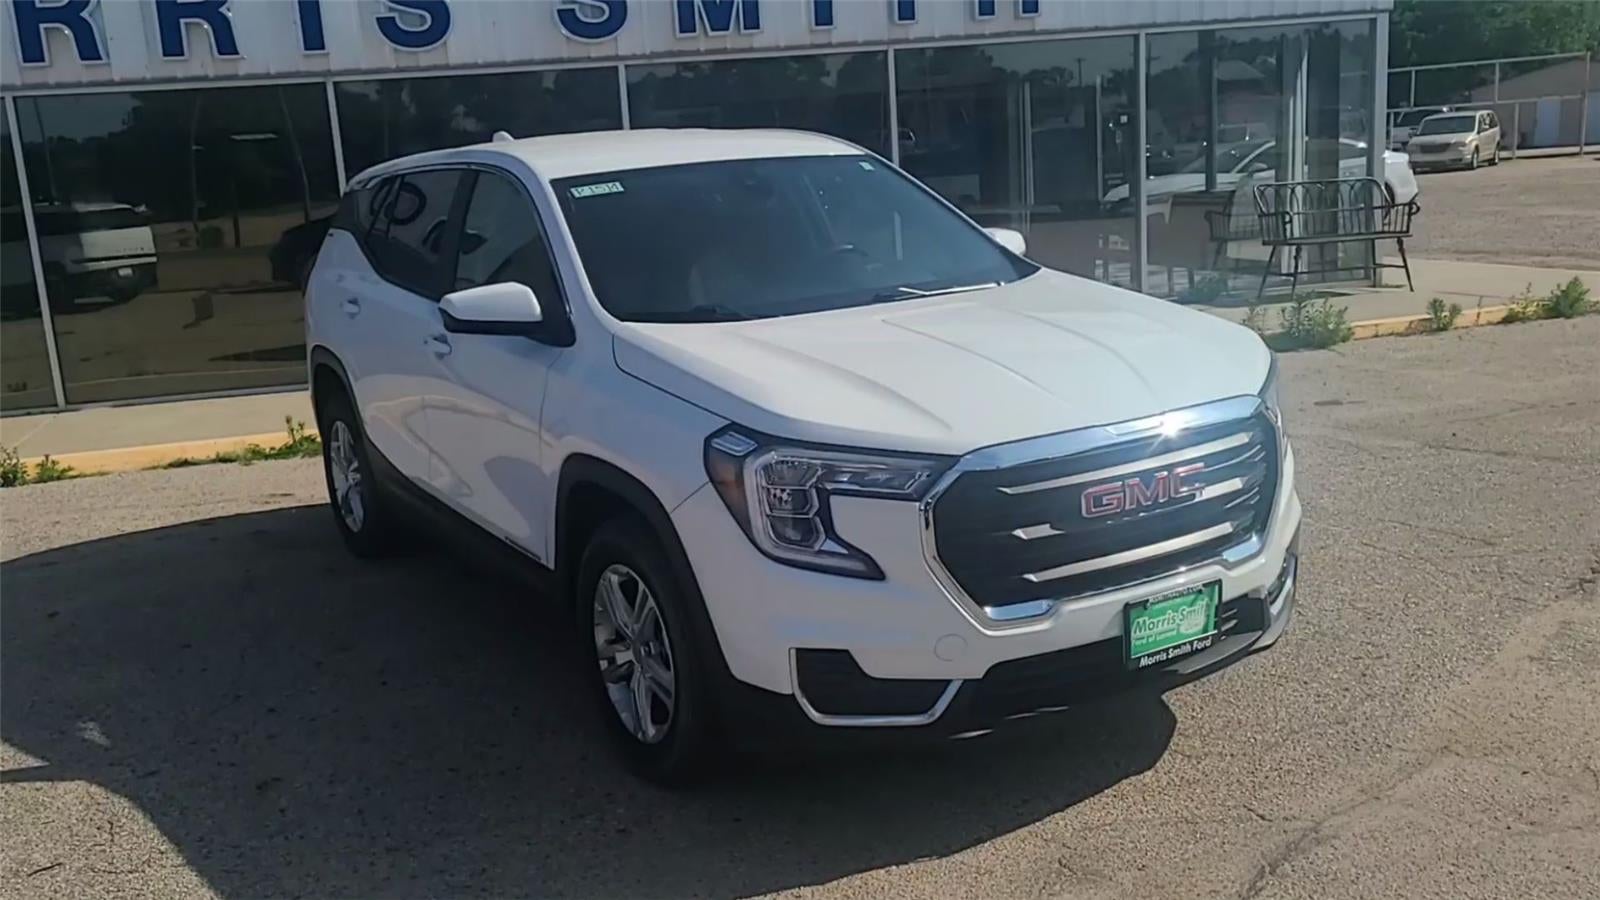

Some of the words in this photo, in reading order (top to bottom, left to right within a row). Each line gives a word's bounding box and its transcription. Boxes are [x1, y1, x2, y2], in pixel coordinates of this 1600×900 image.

[1081, 462, 1206, 518] GMC
[1133, 610, 1177, 635] Morris
[1139, 652, 1167, 668] Morris
[1168, 643, 1192, 659] Smith
[1193, 637, 1212, 652] Ford
